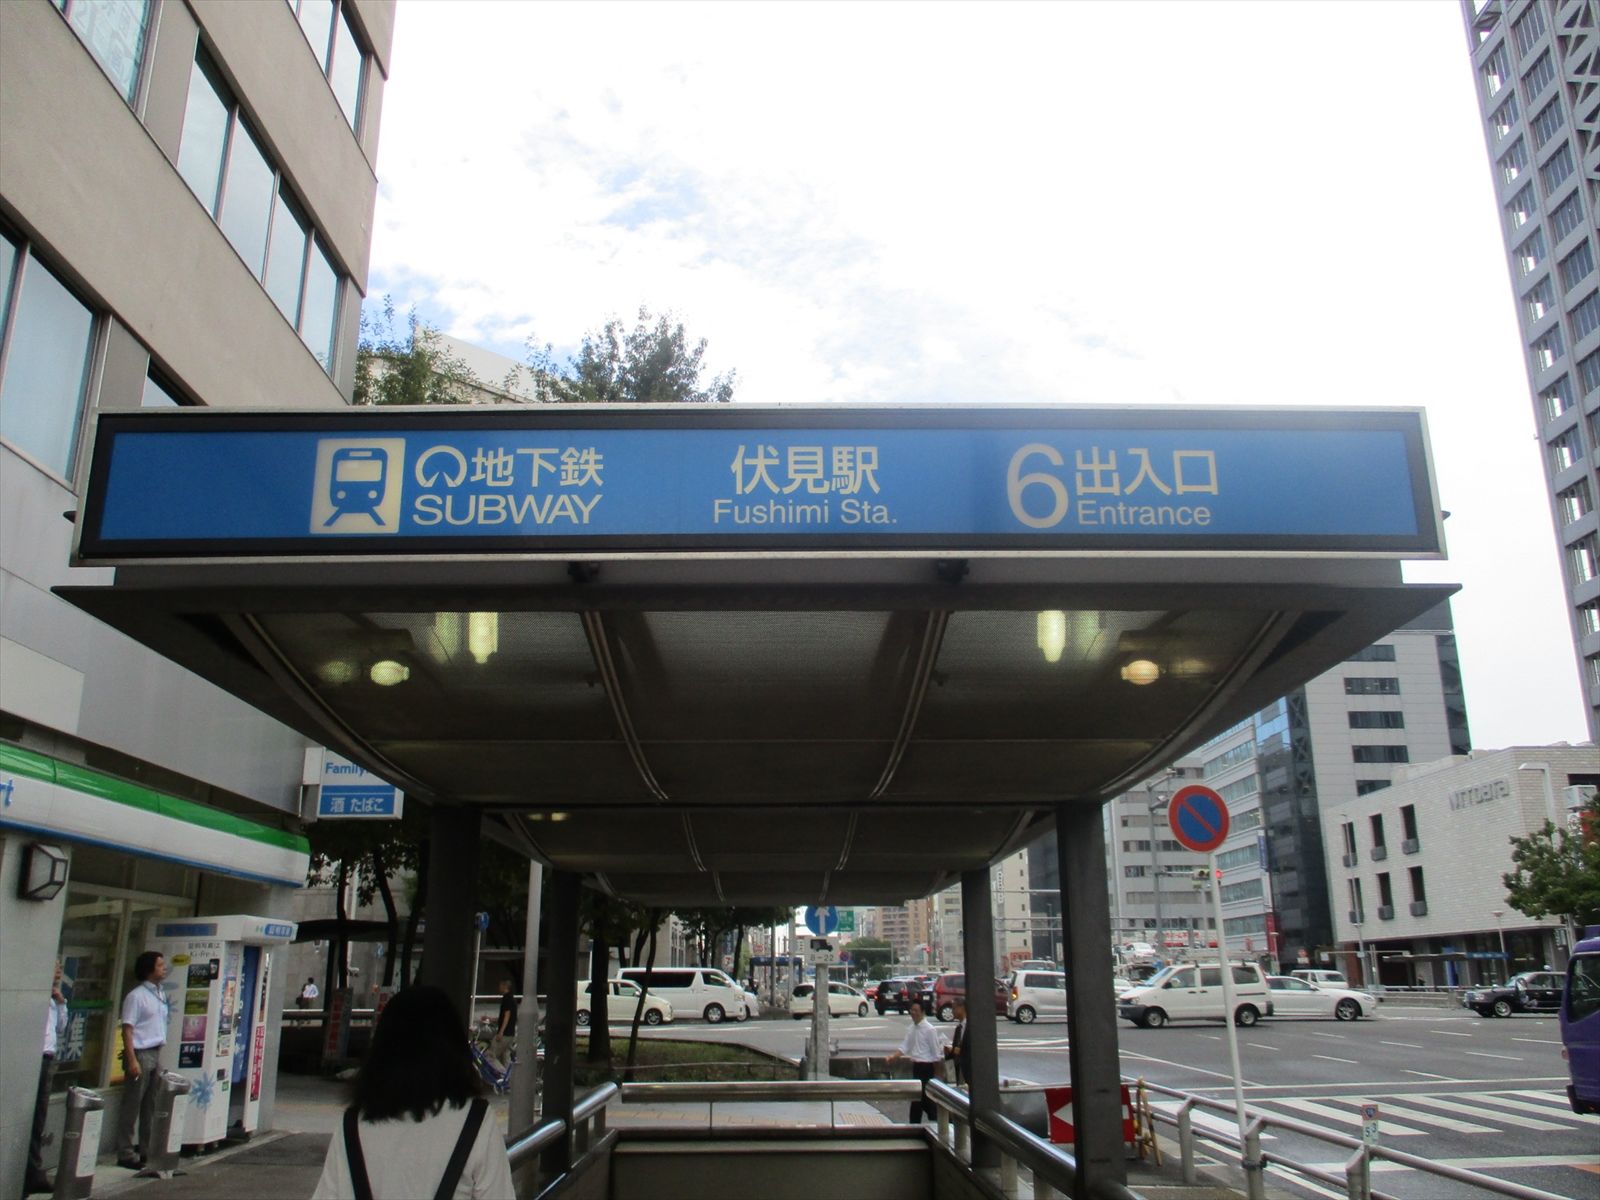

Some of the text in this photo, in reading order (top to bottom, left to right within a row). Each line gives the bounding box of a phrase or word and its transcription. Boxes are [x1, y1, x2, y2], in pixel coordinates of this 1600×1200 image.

[471, 446, 605, 488] 地下鉄
[730, 444, 881, 495] 伏見駅
[1006, 442, 1220, 529] 6 出入口
[412, 494, 603, 526] SUBWAY
[713, 498, 898, 525] Fushimi Sta.
[1077, 500, 1212, 526] Entrance
[325, 762, 371, 776] Family
[330, 796, 384, 813] 酒 たばこ
